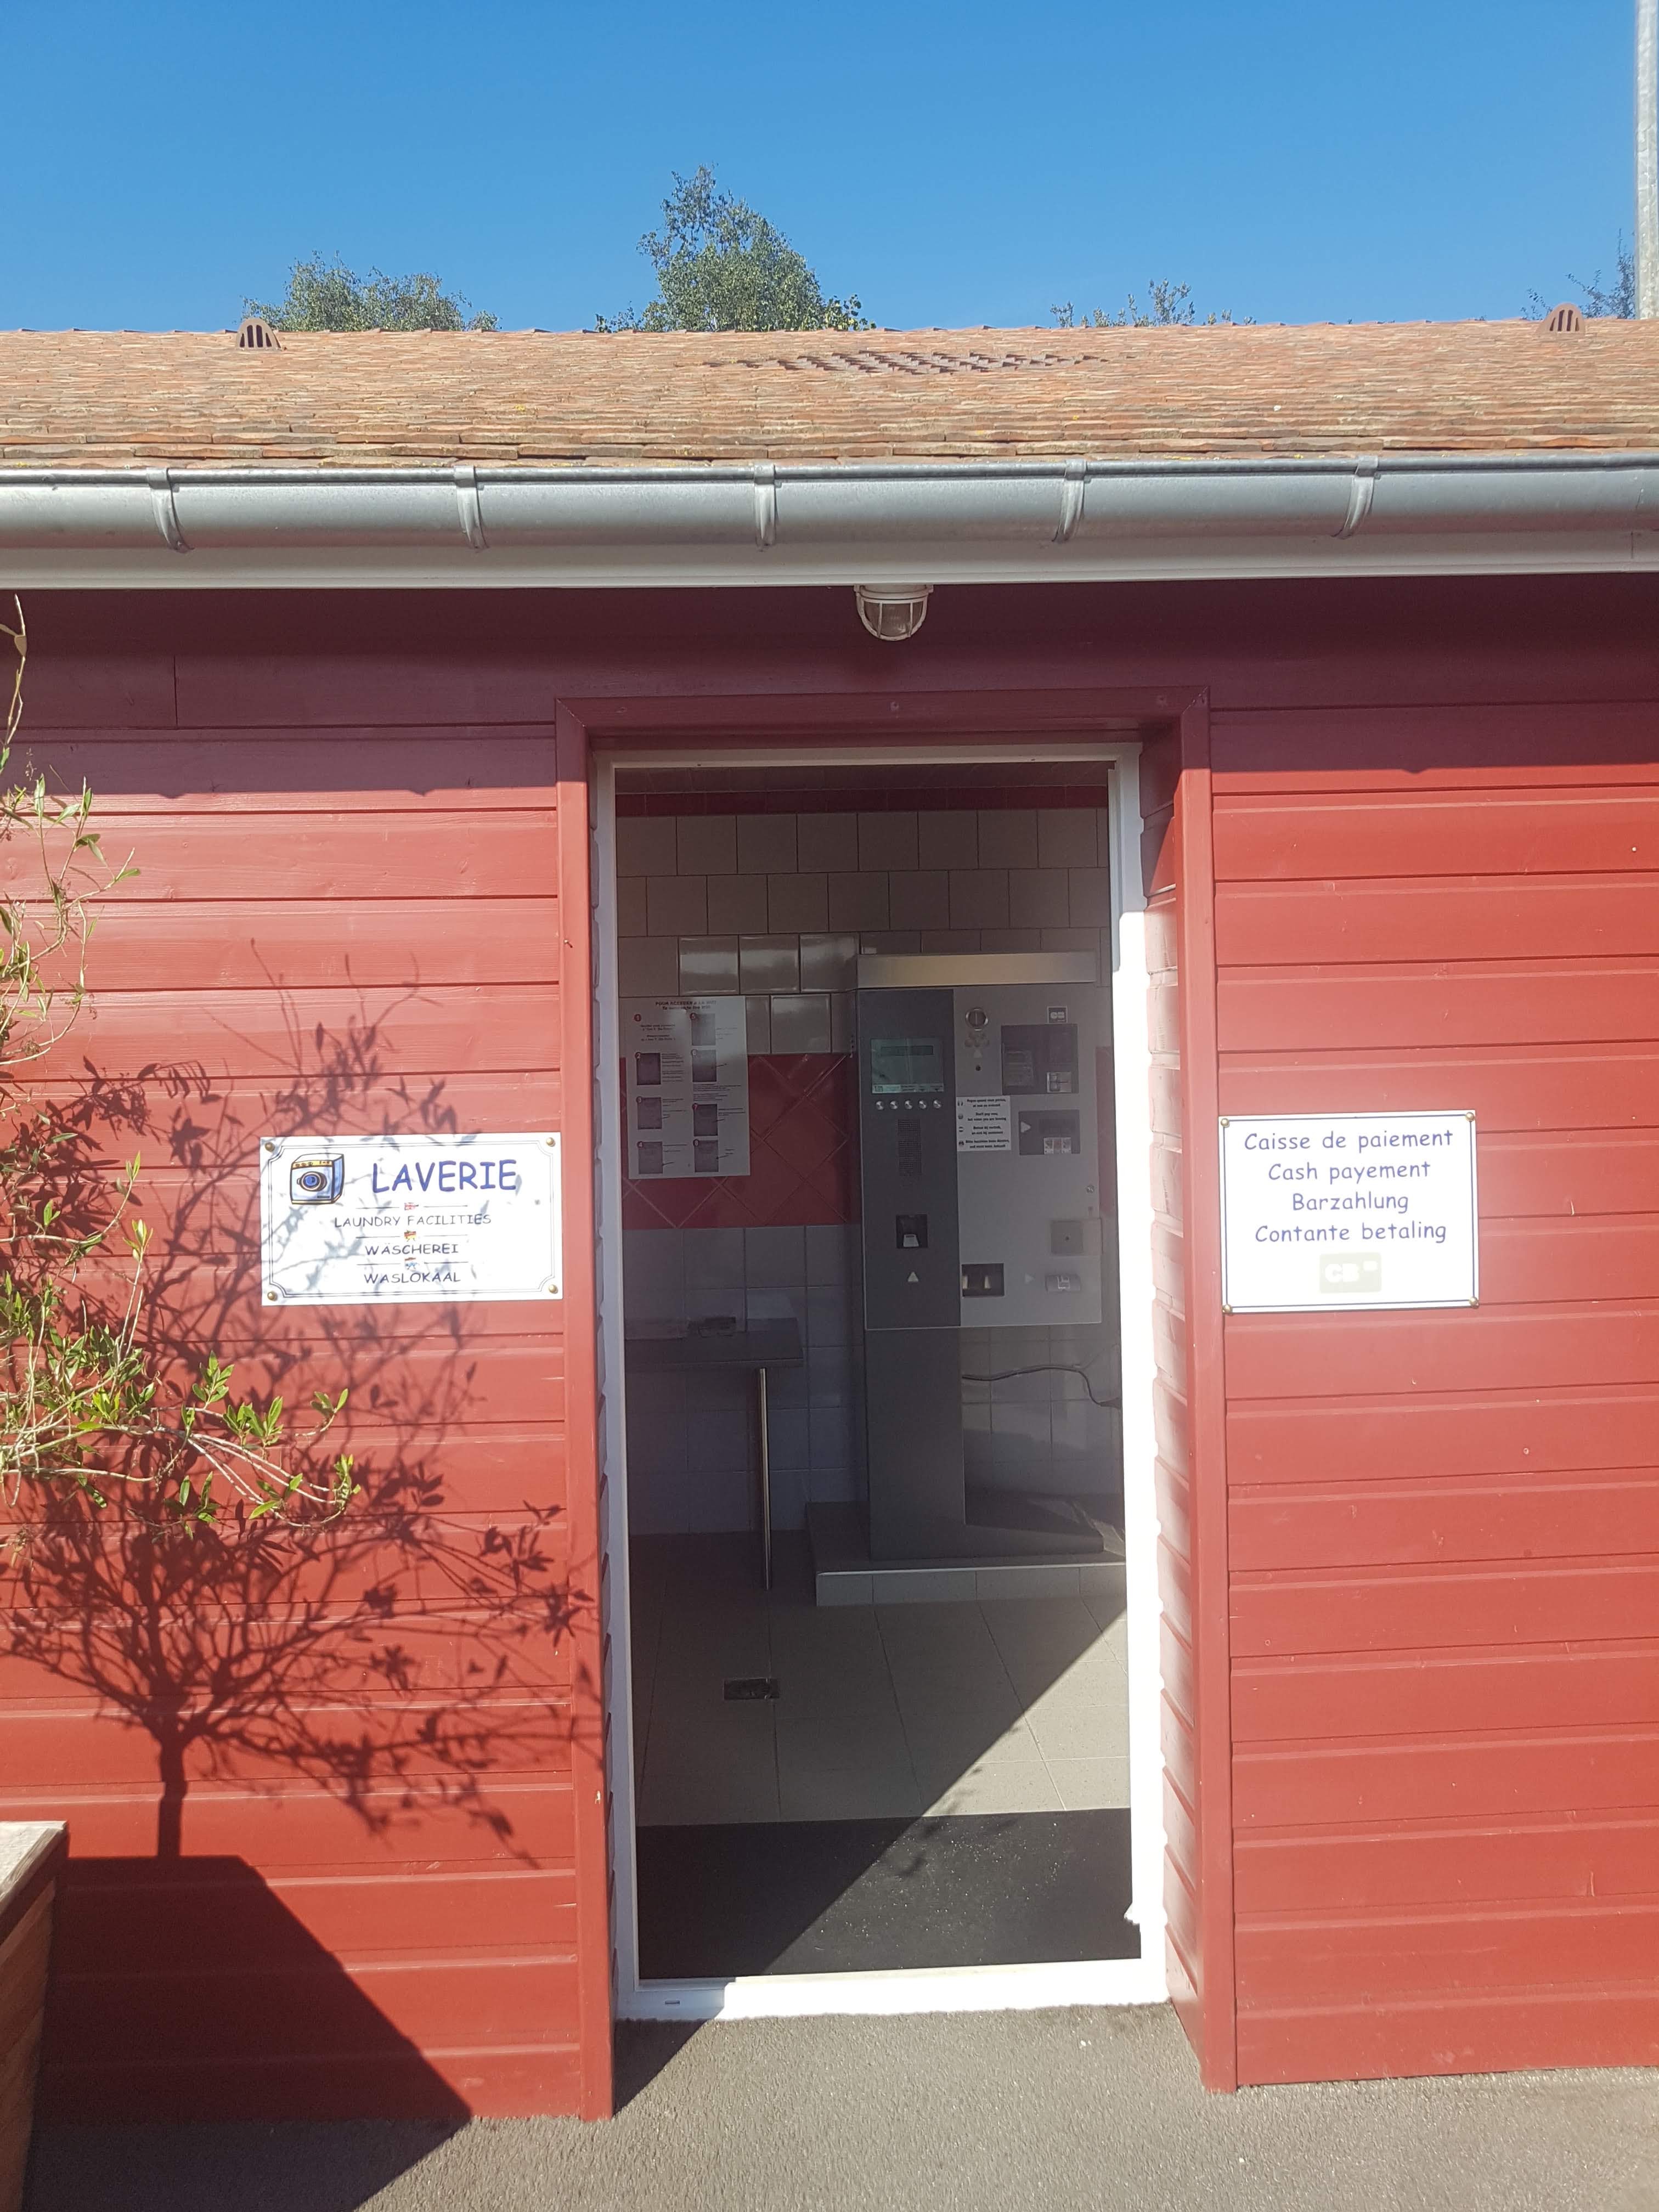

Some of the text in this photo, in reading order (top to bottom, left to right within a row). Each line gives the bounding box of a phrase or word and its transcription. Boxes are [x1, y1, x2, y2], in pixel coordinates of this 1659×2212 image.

[1244, 1130, 1453, 1153] Caisse de paiement
[373, 1159, 517, 1193] LAVERIE
[1268, 1161, 1431, 1184] Cash payement
[1293, 1191, 1409, 1214] Barzahlung
[335, 1214, 492, 1228] LAUNDRY FACILITIES
[1255, 1221, 1447, 1244] Contante betaling
[365, 1243, 459, 1256] WÄSCHEREI
[364, 1271, 461, 1284] WASLOKAAL
